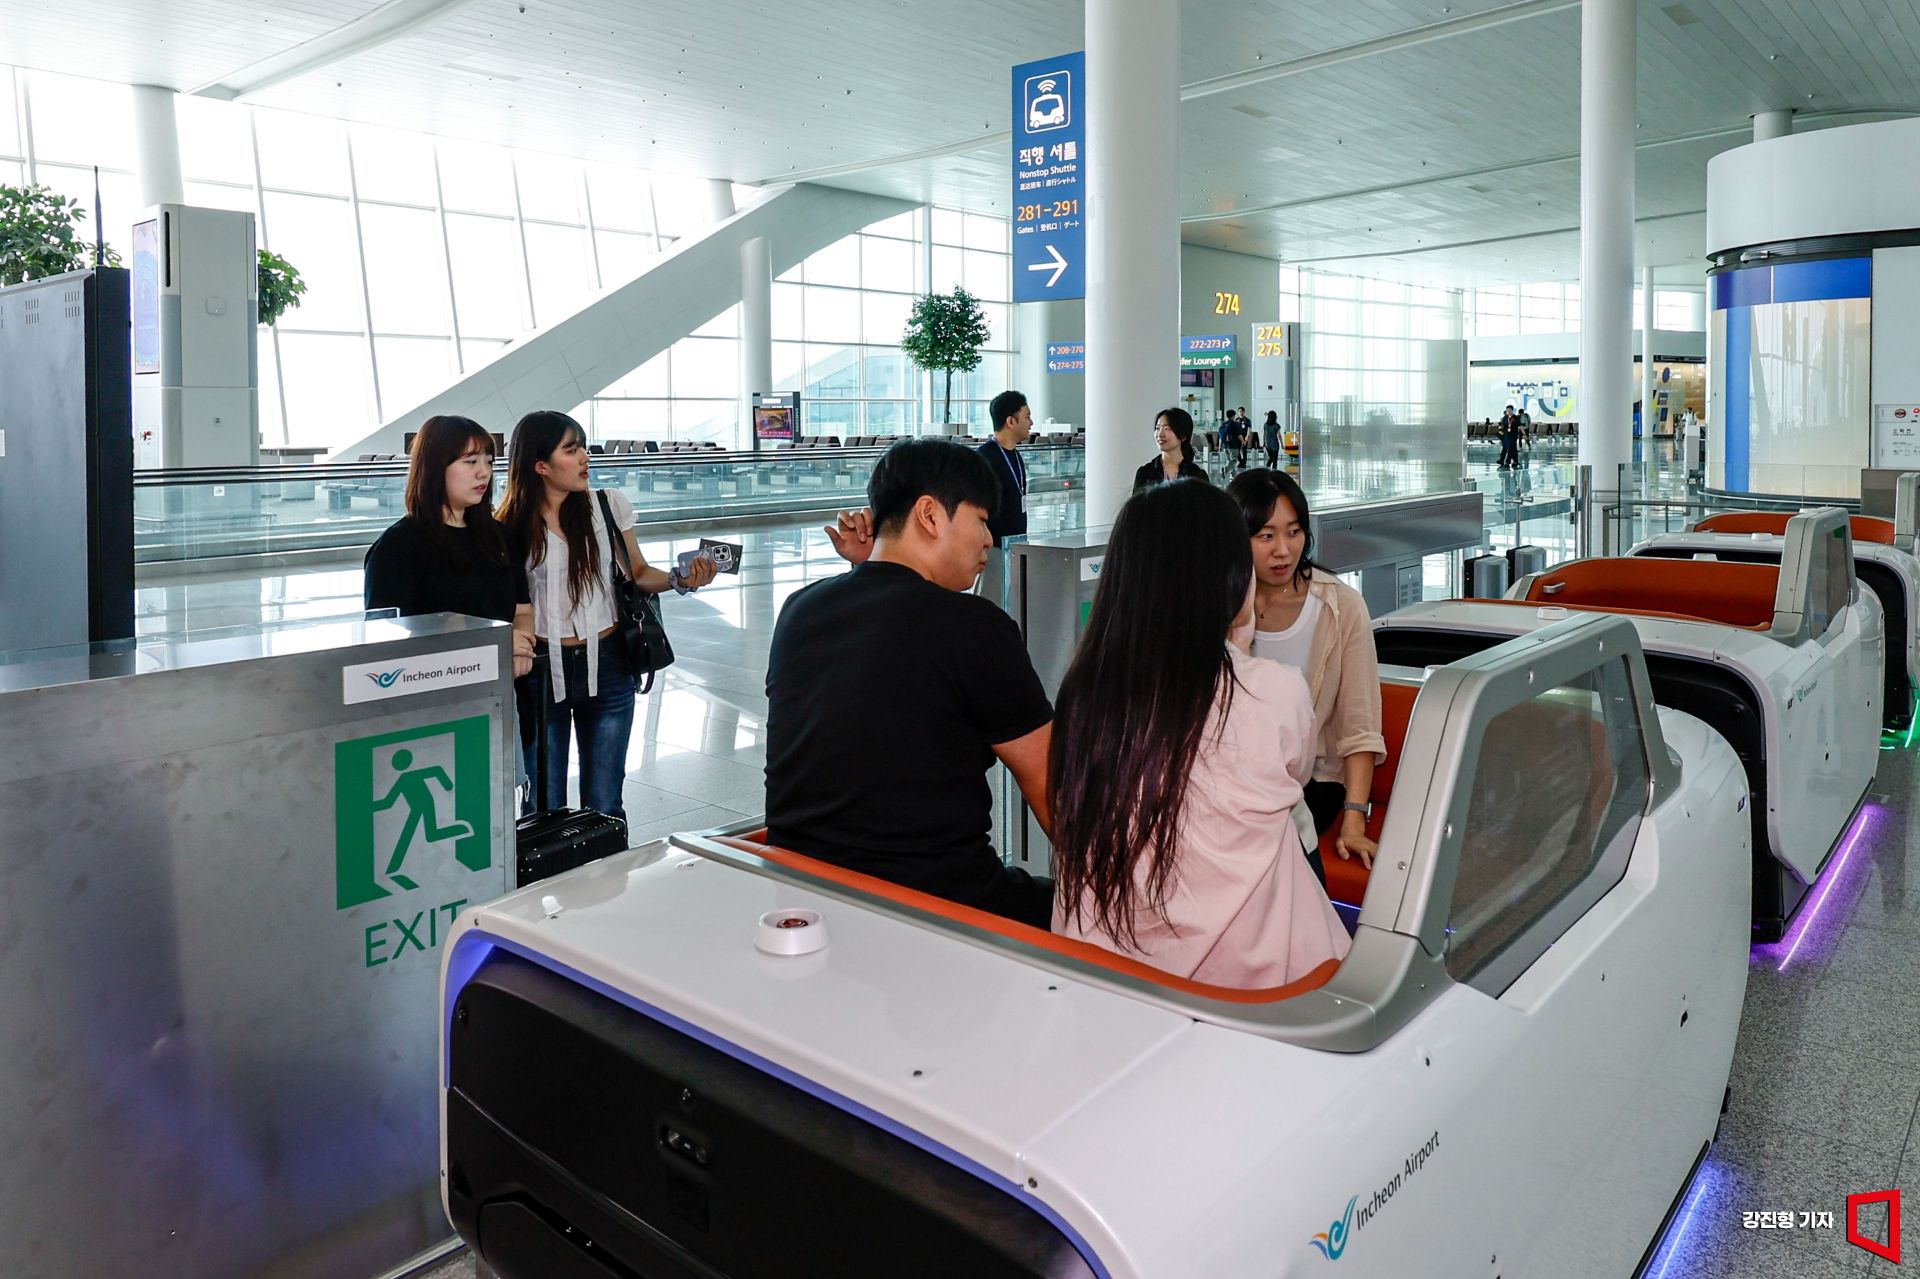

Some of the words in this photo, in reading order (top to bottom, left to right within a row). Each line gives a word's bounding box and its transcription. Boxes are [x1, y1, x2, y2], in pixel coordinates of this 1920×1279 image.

[1020, 146, 1043, 166] 직행
[1050, 141, 1077, 161] 셔틀
[1019, 169, 1049, 179] Nonstop
[1050, 163, 1077, 174] Shuttle
[1017, 200, 1078, 221] 281-291
[1017, 226, 1034, 234] Gates
[1215, 292, 1240, 316] 274
[1257, 326, 1283, 341] 274
[1189, 339, 1222, 349] 272-273
[1257, 342, 1283, 357] 275
[1193, 356, 1222, 367] Lounge
[402, 670, 443, 683] Incheon
[446, 663, 481, 676] Airport
[365, 899, 468, 968] EXIT
[1356, 1173, 1401, 1231] Incheon
[1404, 1130, 1440, 1182] Airport
